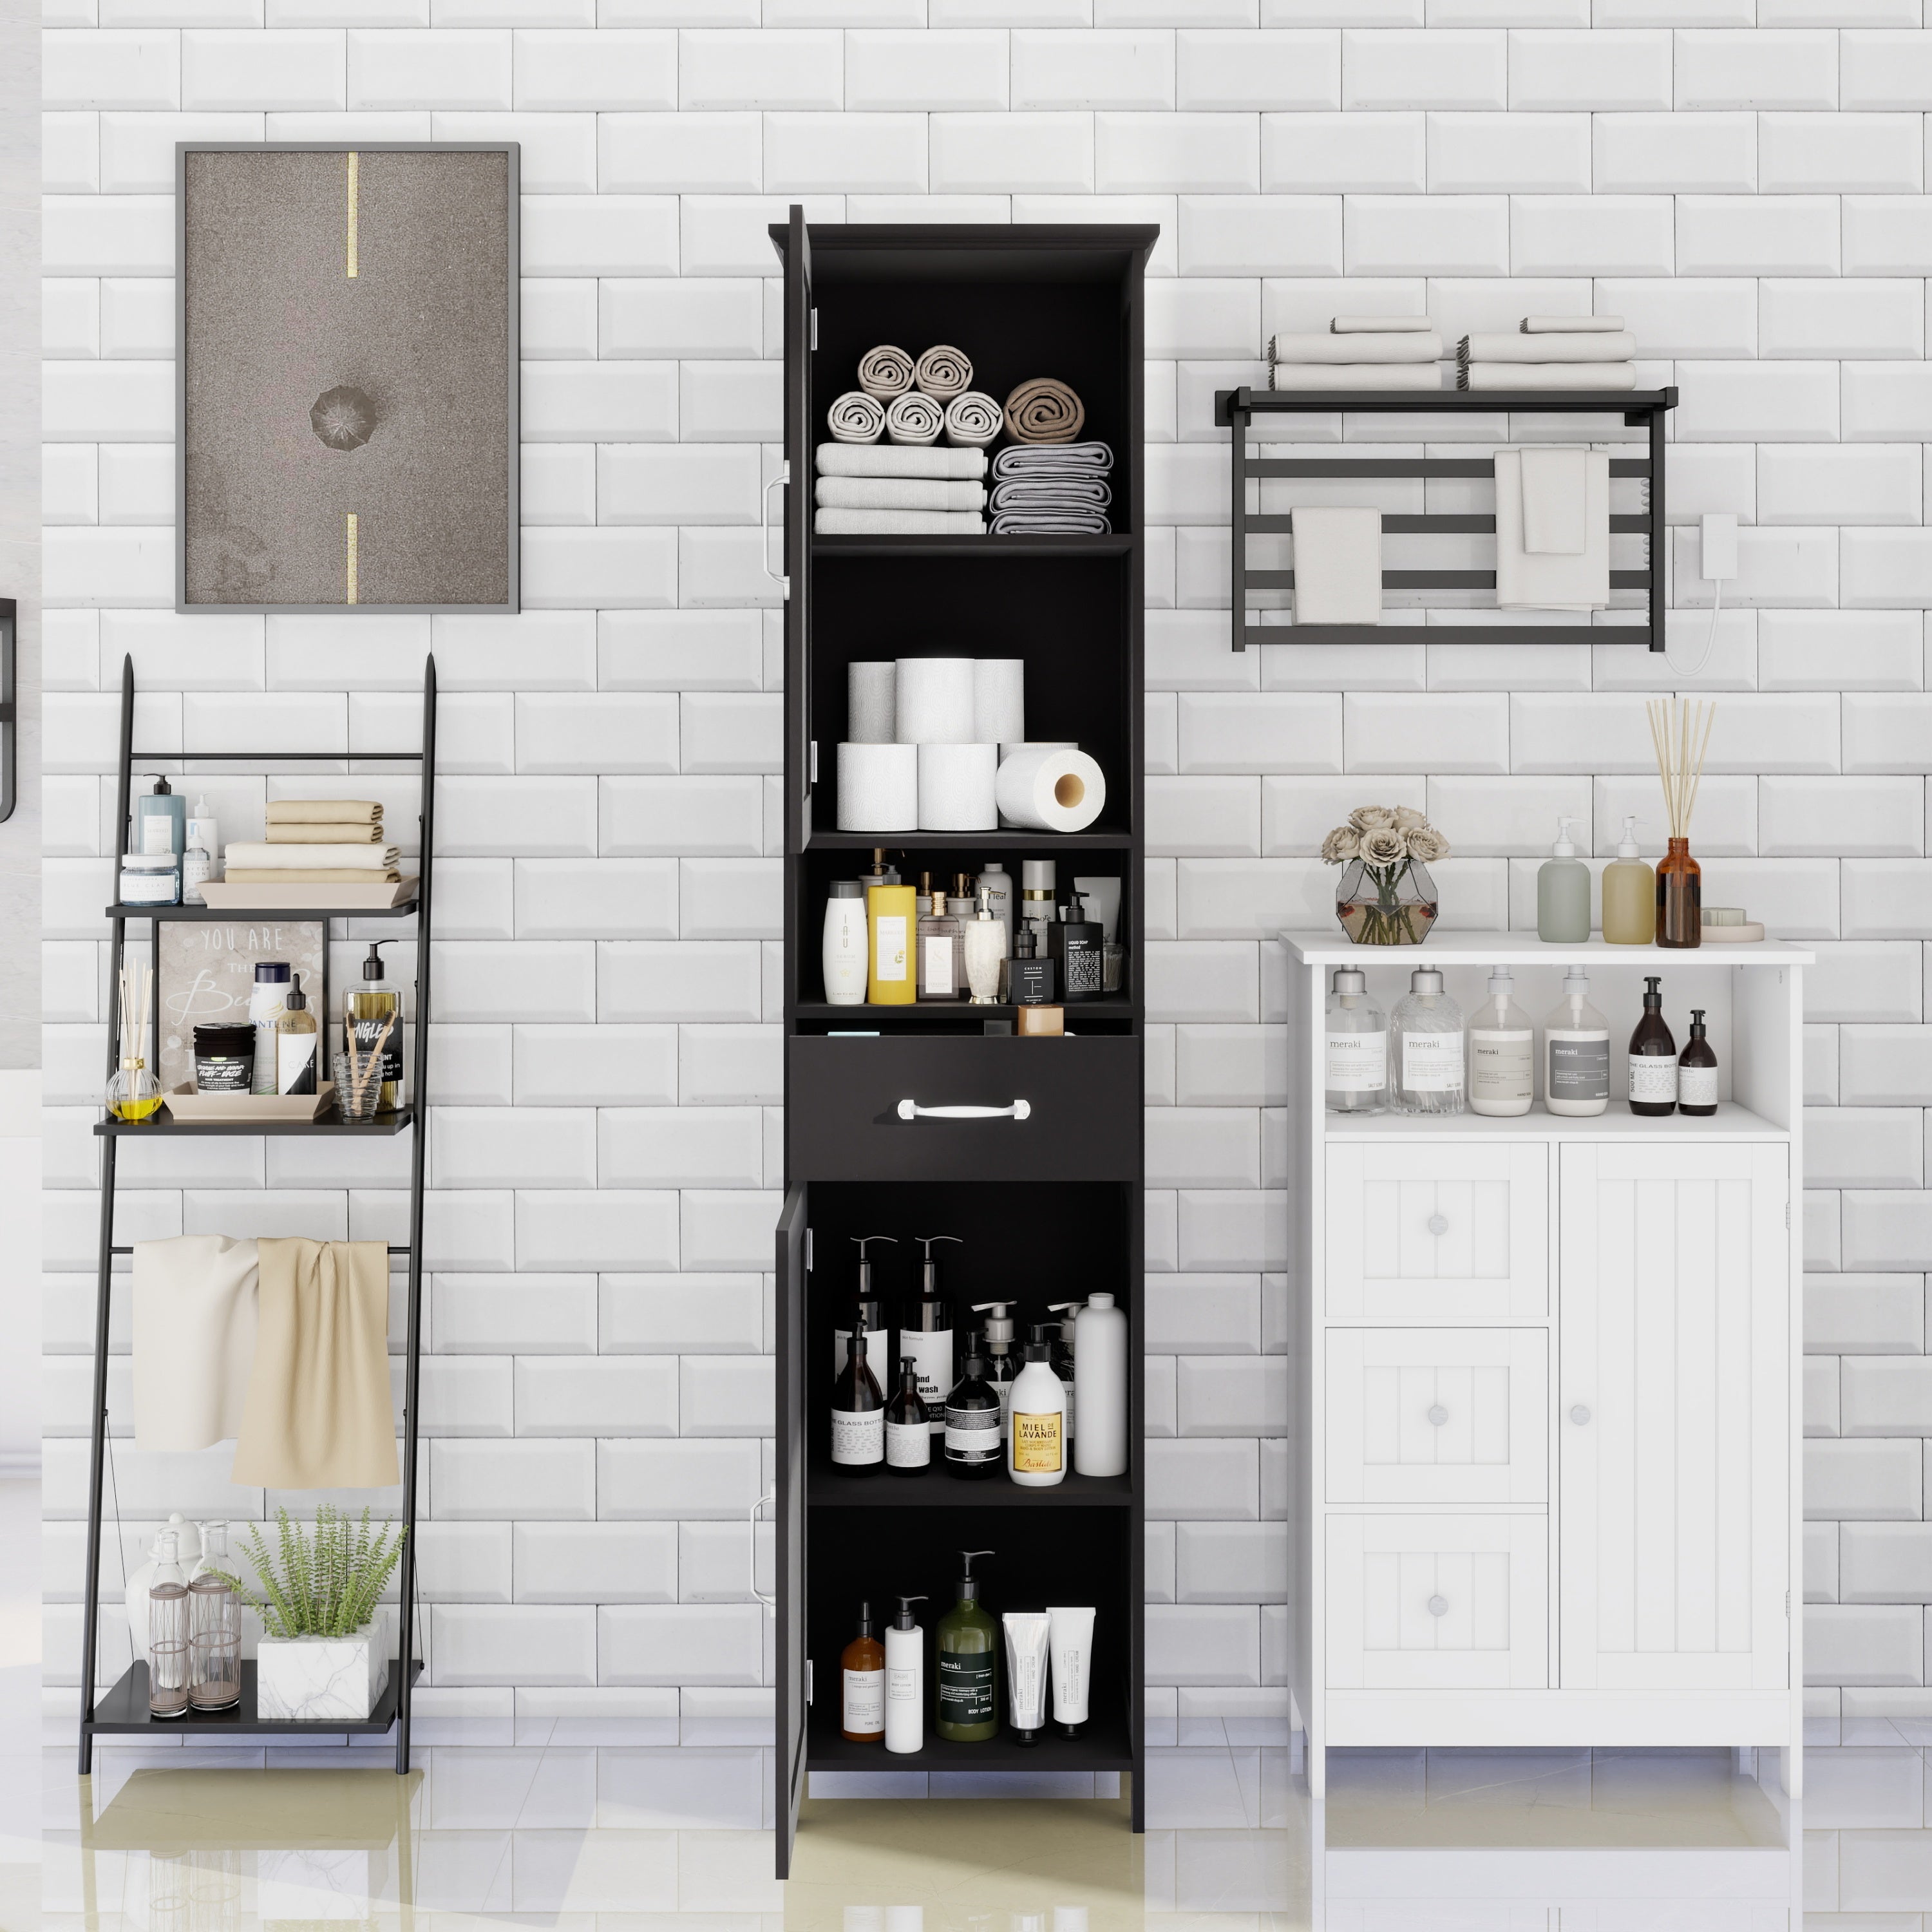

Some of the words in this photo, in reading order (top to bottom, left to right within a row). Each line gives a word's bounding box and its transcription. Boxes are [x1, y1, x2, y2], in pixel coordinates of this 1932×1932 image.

[200, 929, 235, 951] YOU
[249, 927, 283, 951] ARE
[227, 963, 255, 973] THE
[288, 1059, 314, 1069] CAKE
[1630, 1070, 1635, 1079] ML
[918, 1385, 938, 1394] wash
[940, 1661, 961, 1670] meraki
